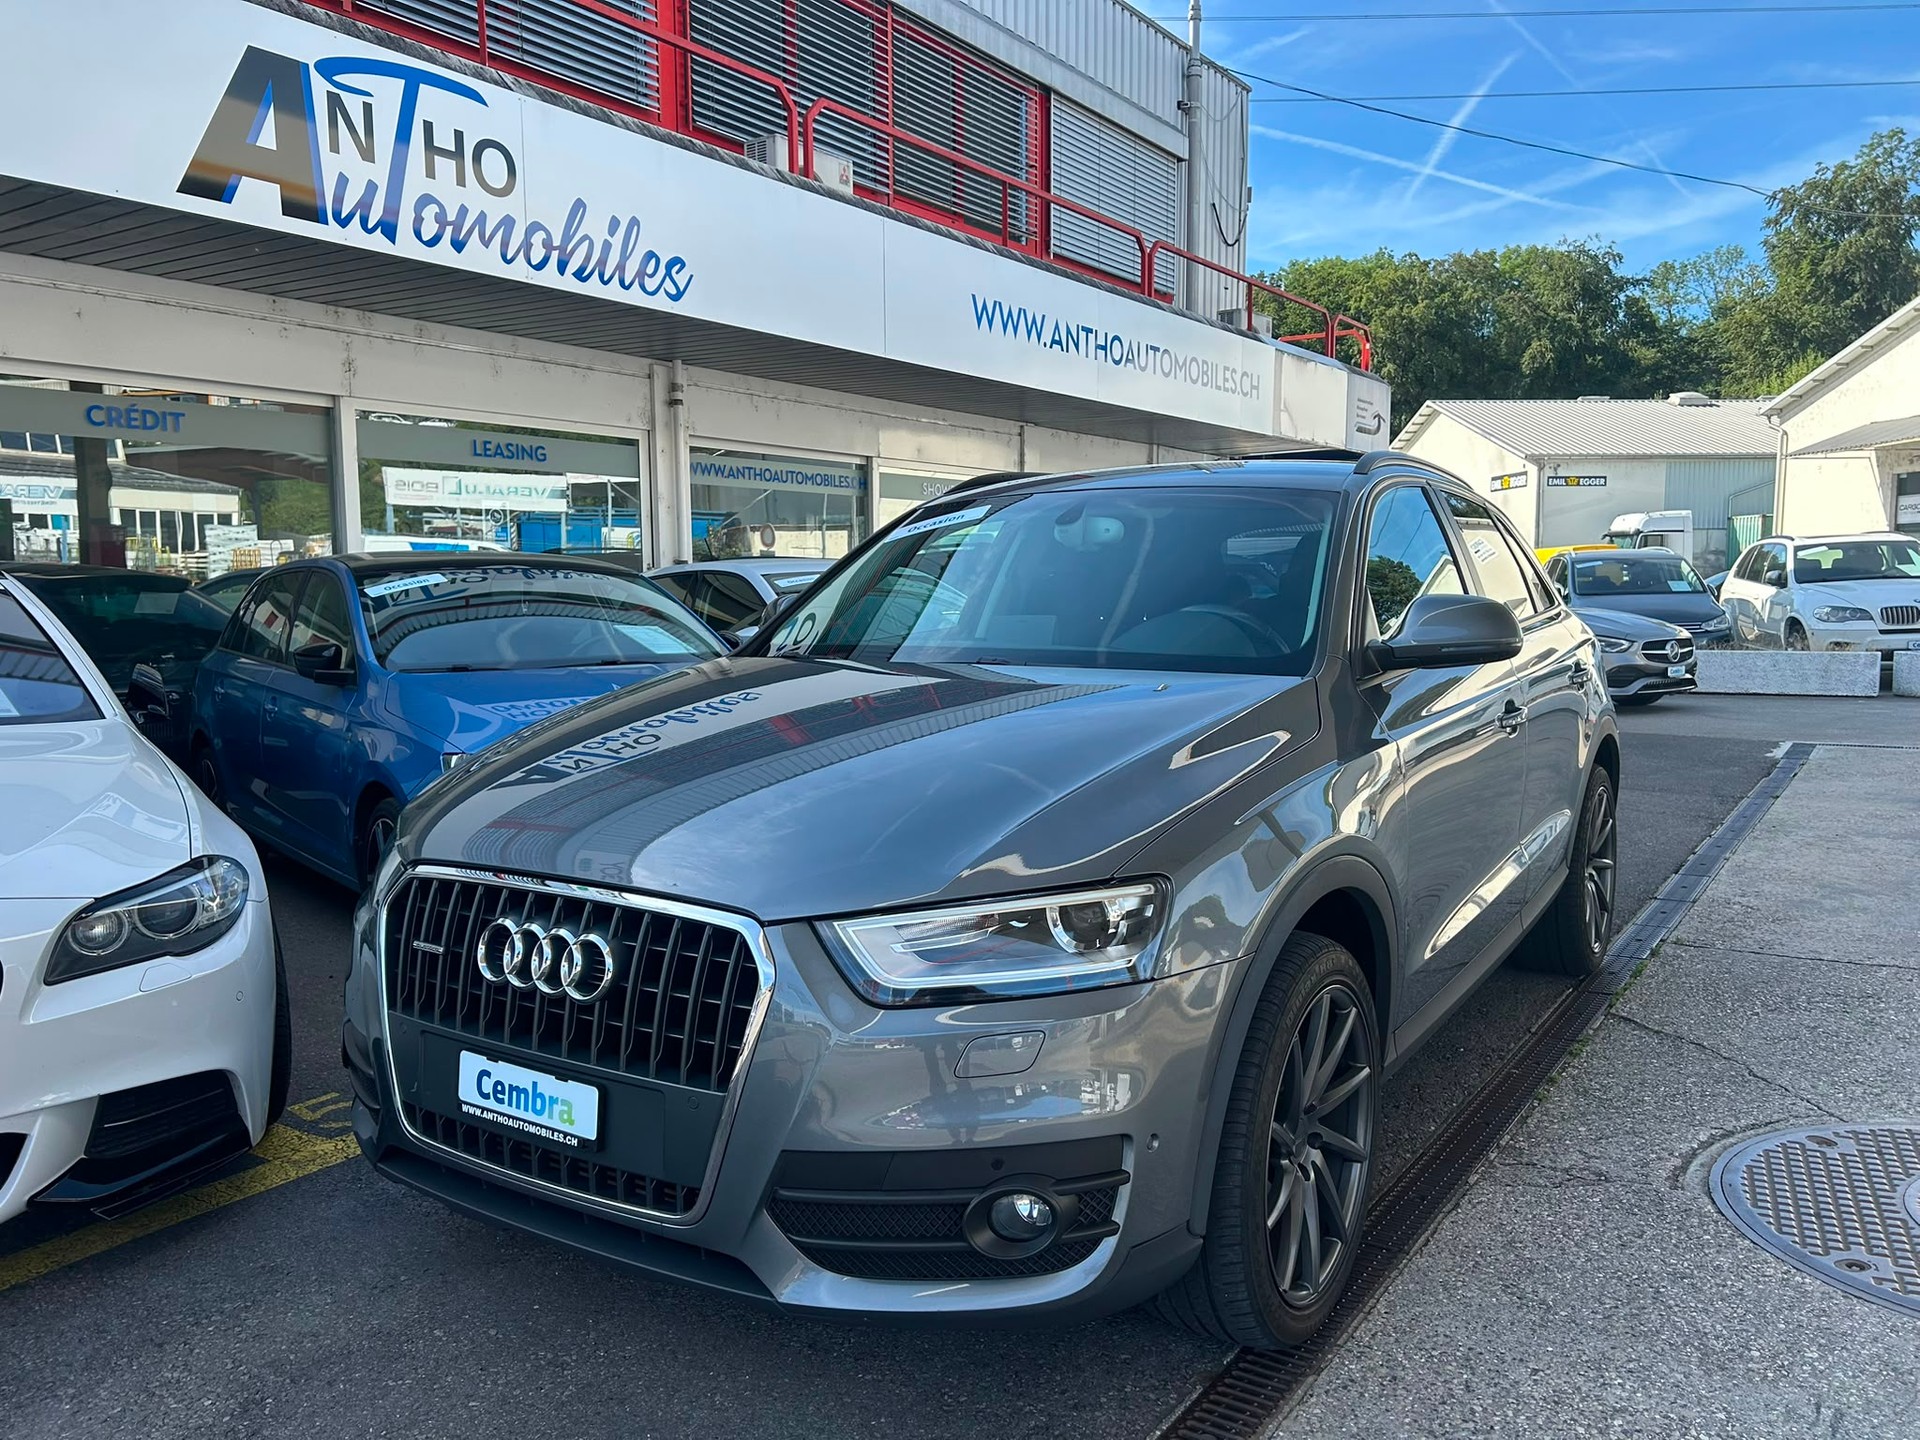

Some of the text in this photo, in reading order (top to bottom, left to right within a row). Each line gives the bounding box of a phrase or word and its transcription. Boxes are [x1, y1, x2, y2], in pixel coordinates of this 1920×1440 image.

[971, 293, 1260, 400] WWW.ANTHOAUTOMOBILES.CH
[86, 403, 185, 432] CRÉDIT
[473, 439, 547, 462] LEASING
[907, 514, 965, 533] Occasion
[384, 578, 430, 591] Occasion
[476, 1068, 576, 1127] Cembra
[461, 1103, 578, 1147] WWW.ANTHOAUTOMOBILES.CH
